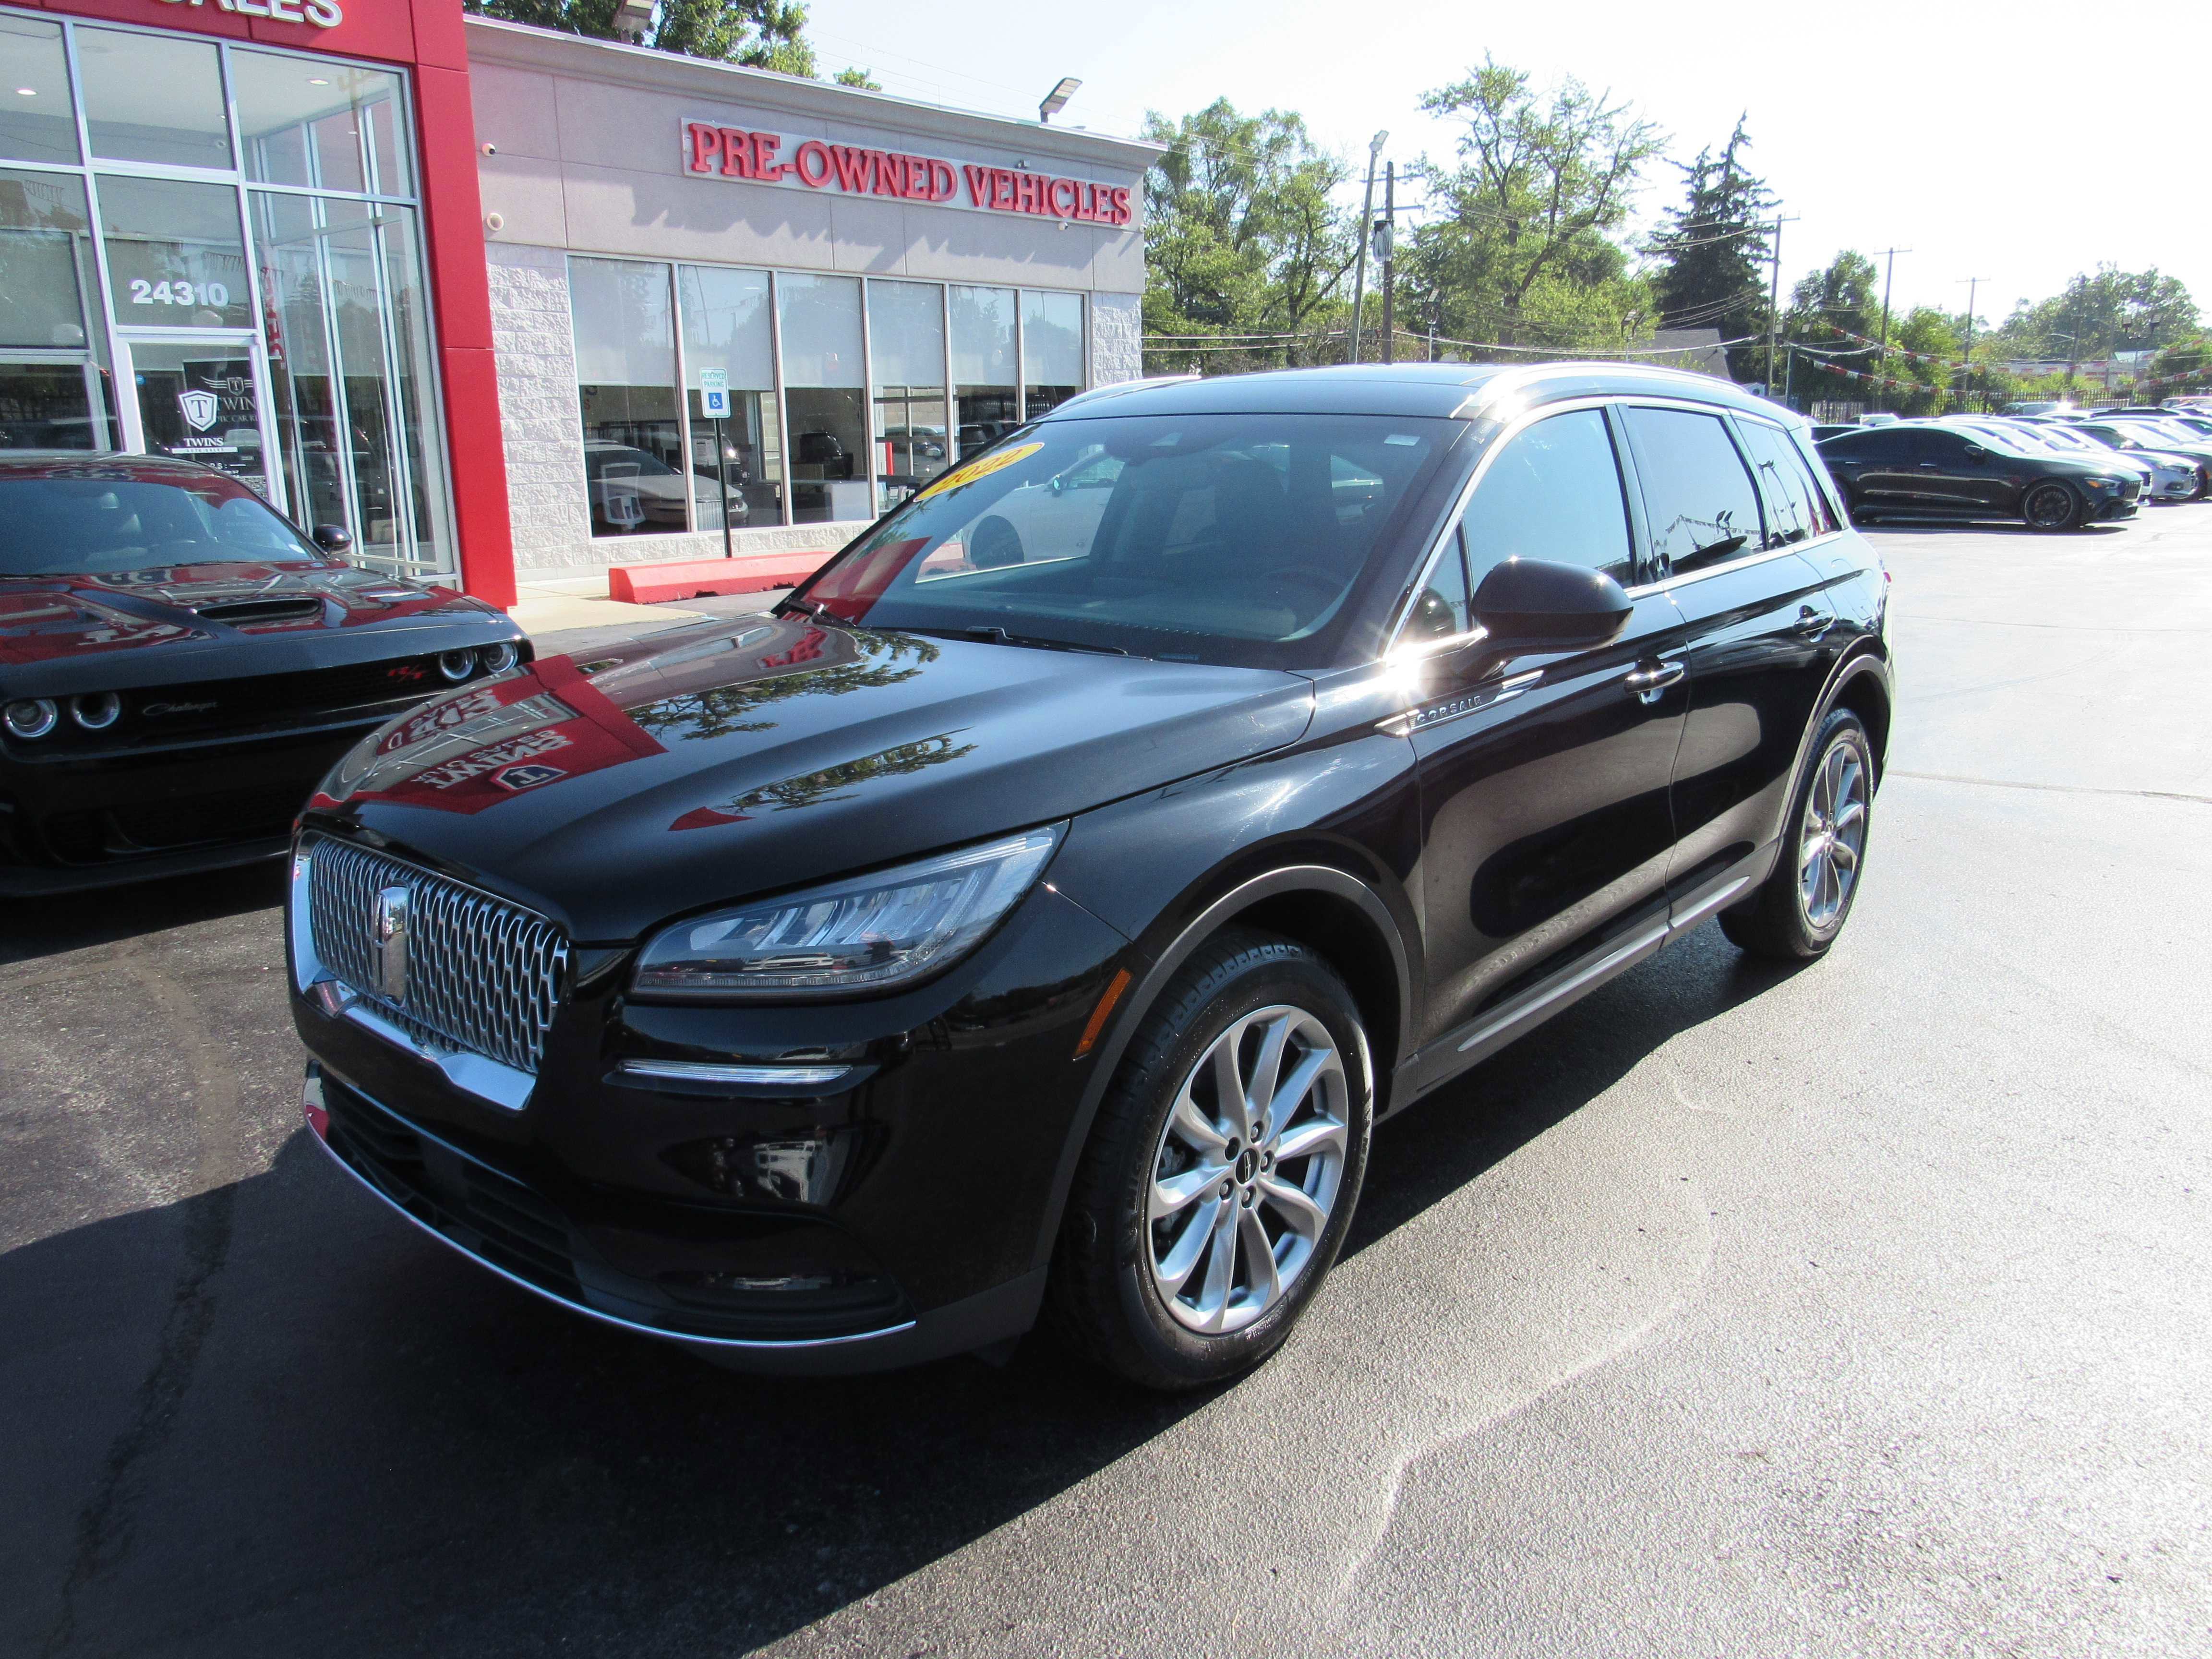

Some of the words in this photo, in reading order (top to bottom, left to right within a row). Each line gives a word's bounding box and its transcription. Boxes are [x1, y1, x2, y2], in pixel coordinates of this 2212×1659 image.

[688, 123, 958, 202] PRE-OWNED
[964, 165, 1132, 225] VEHICLES
[131, 280, 229, 308] 24310
[183, 437, 224, 447] TWINS
[142, 702, 218, 716] Challenger
[1417, 696, 1482, 723] CORSAIR
